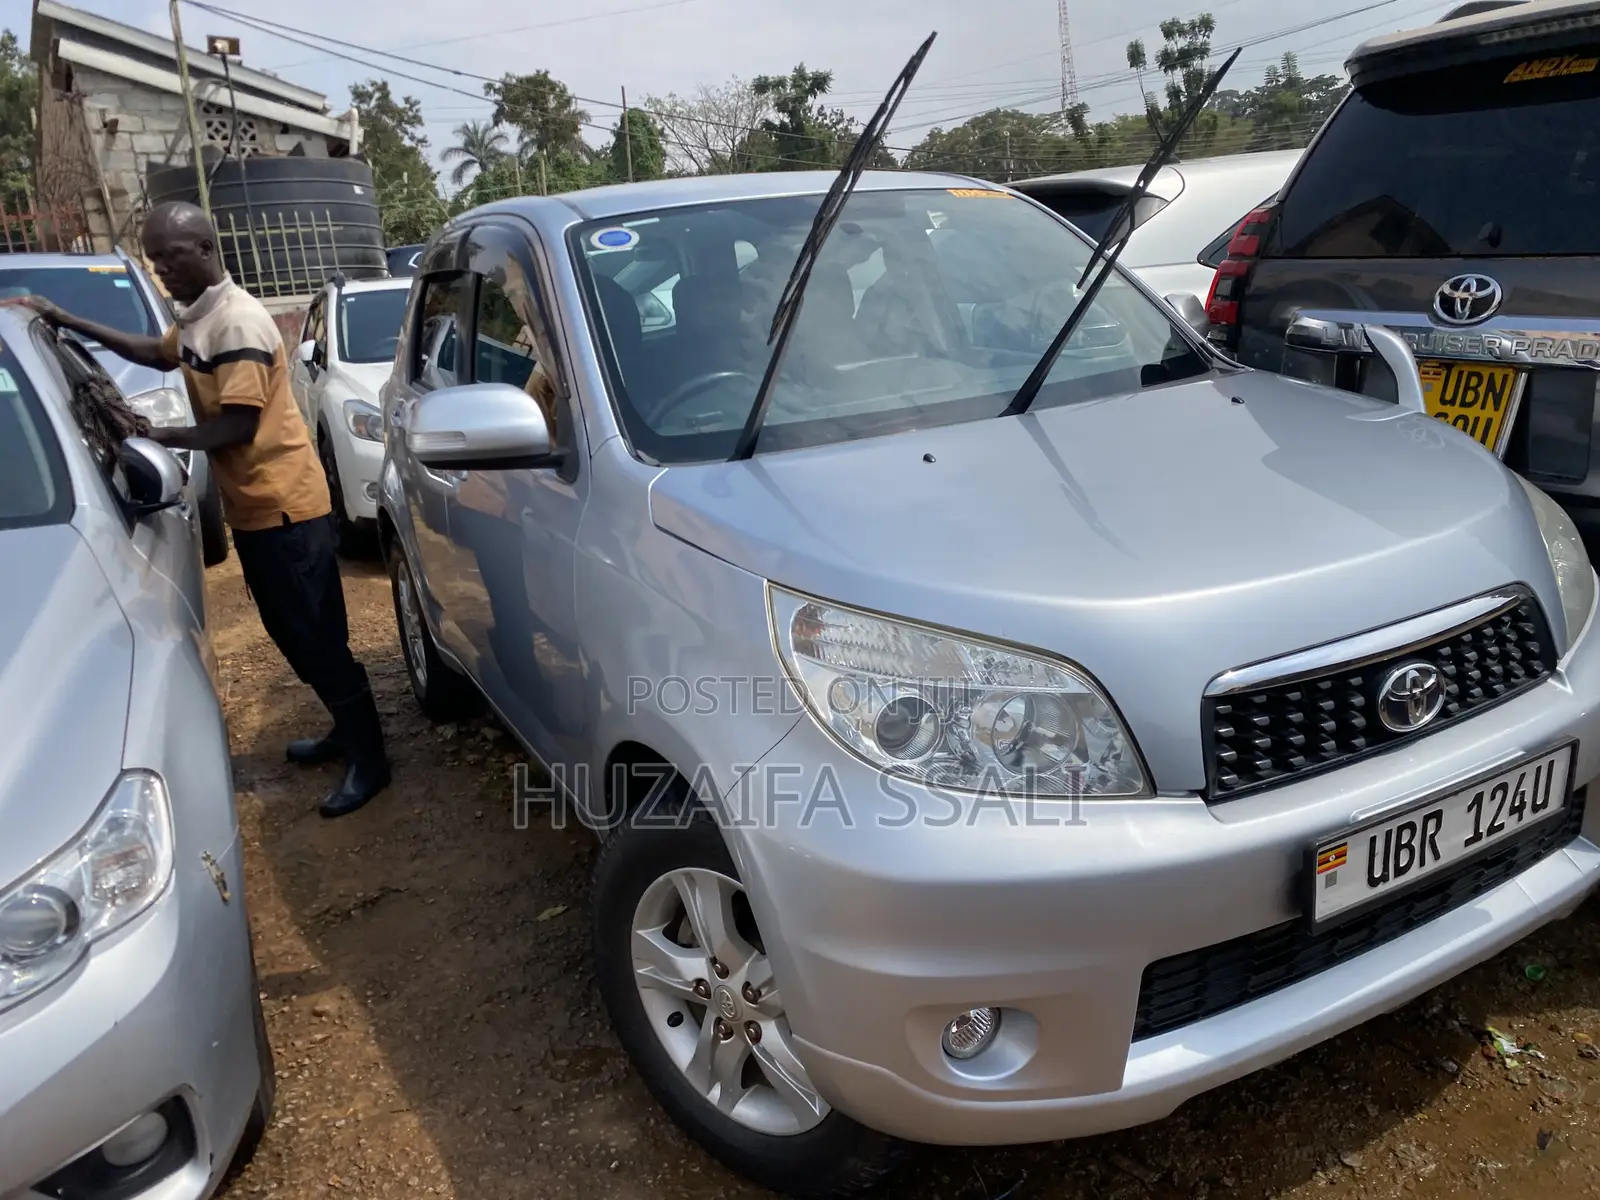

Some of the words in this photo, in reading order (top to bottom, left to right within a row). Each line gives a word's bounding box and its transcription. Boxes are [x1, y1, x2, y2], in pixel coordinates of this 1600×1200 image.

[1401, 332, 1502, 356] RUISER
[1510, 336, 1600, 359] PRAD
[1439, 369, 1509, 412] UBN
[1367, 808, 1443, 888] UBR
[1463, 759, 1555, 848] 124U
